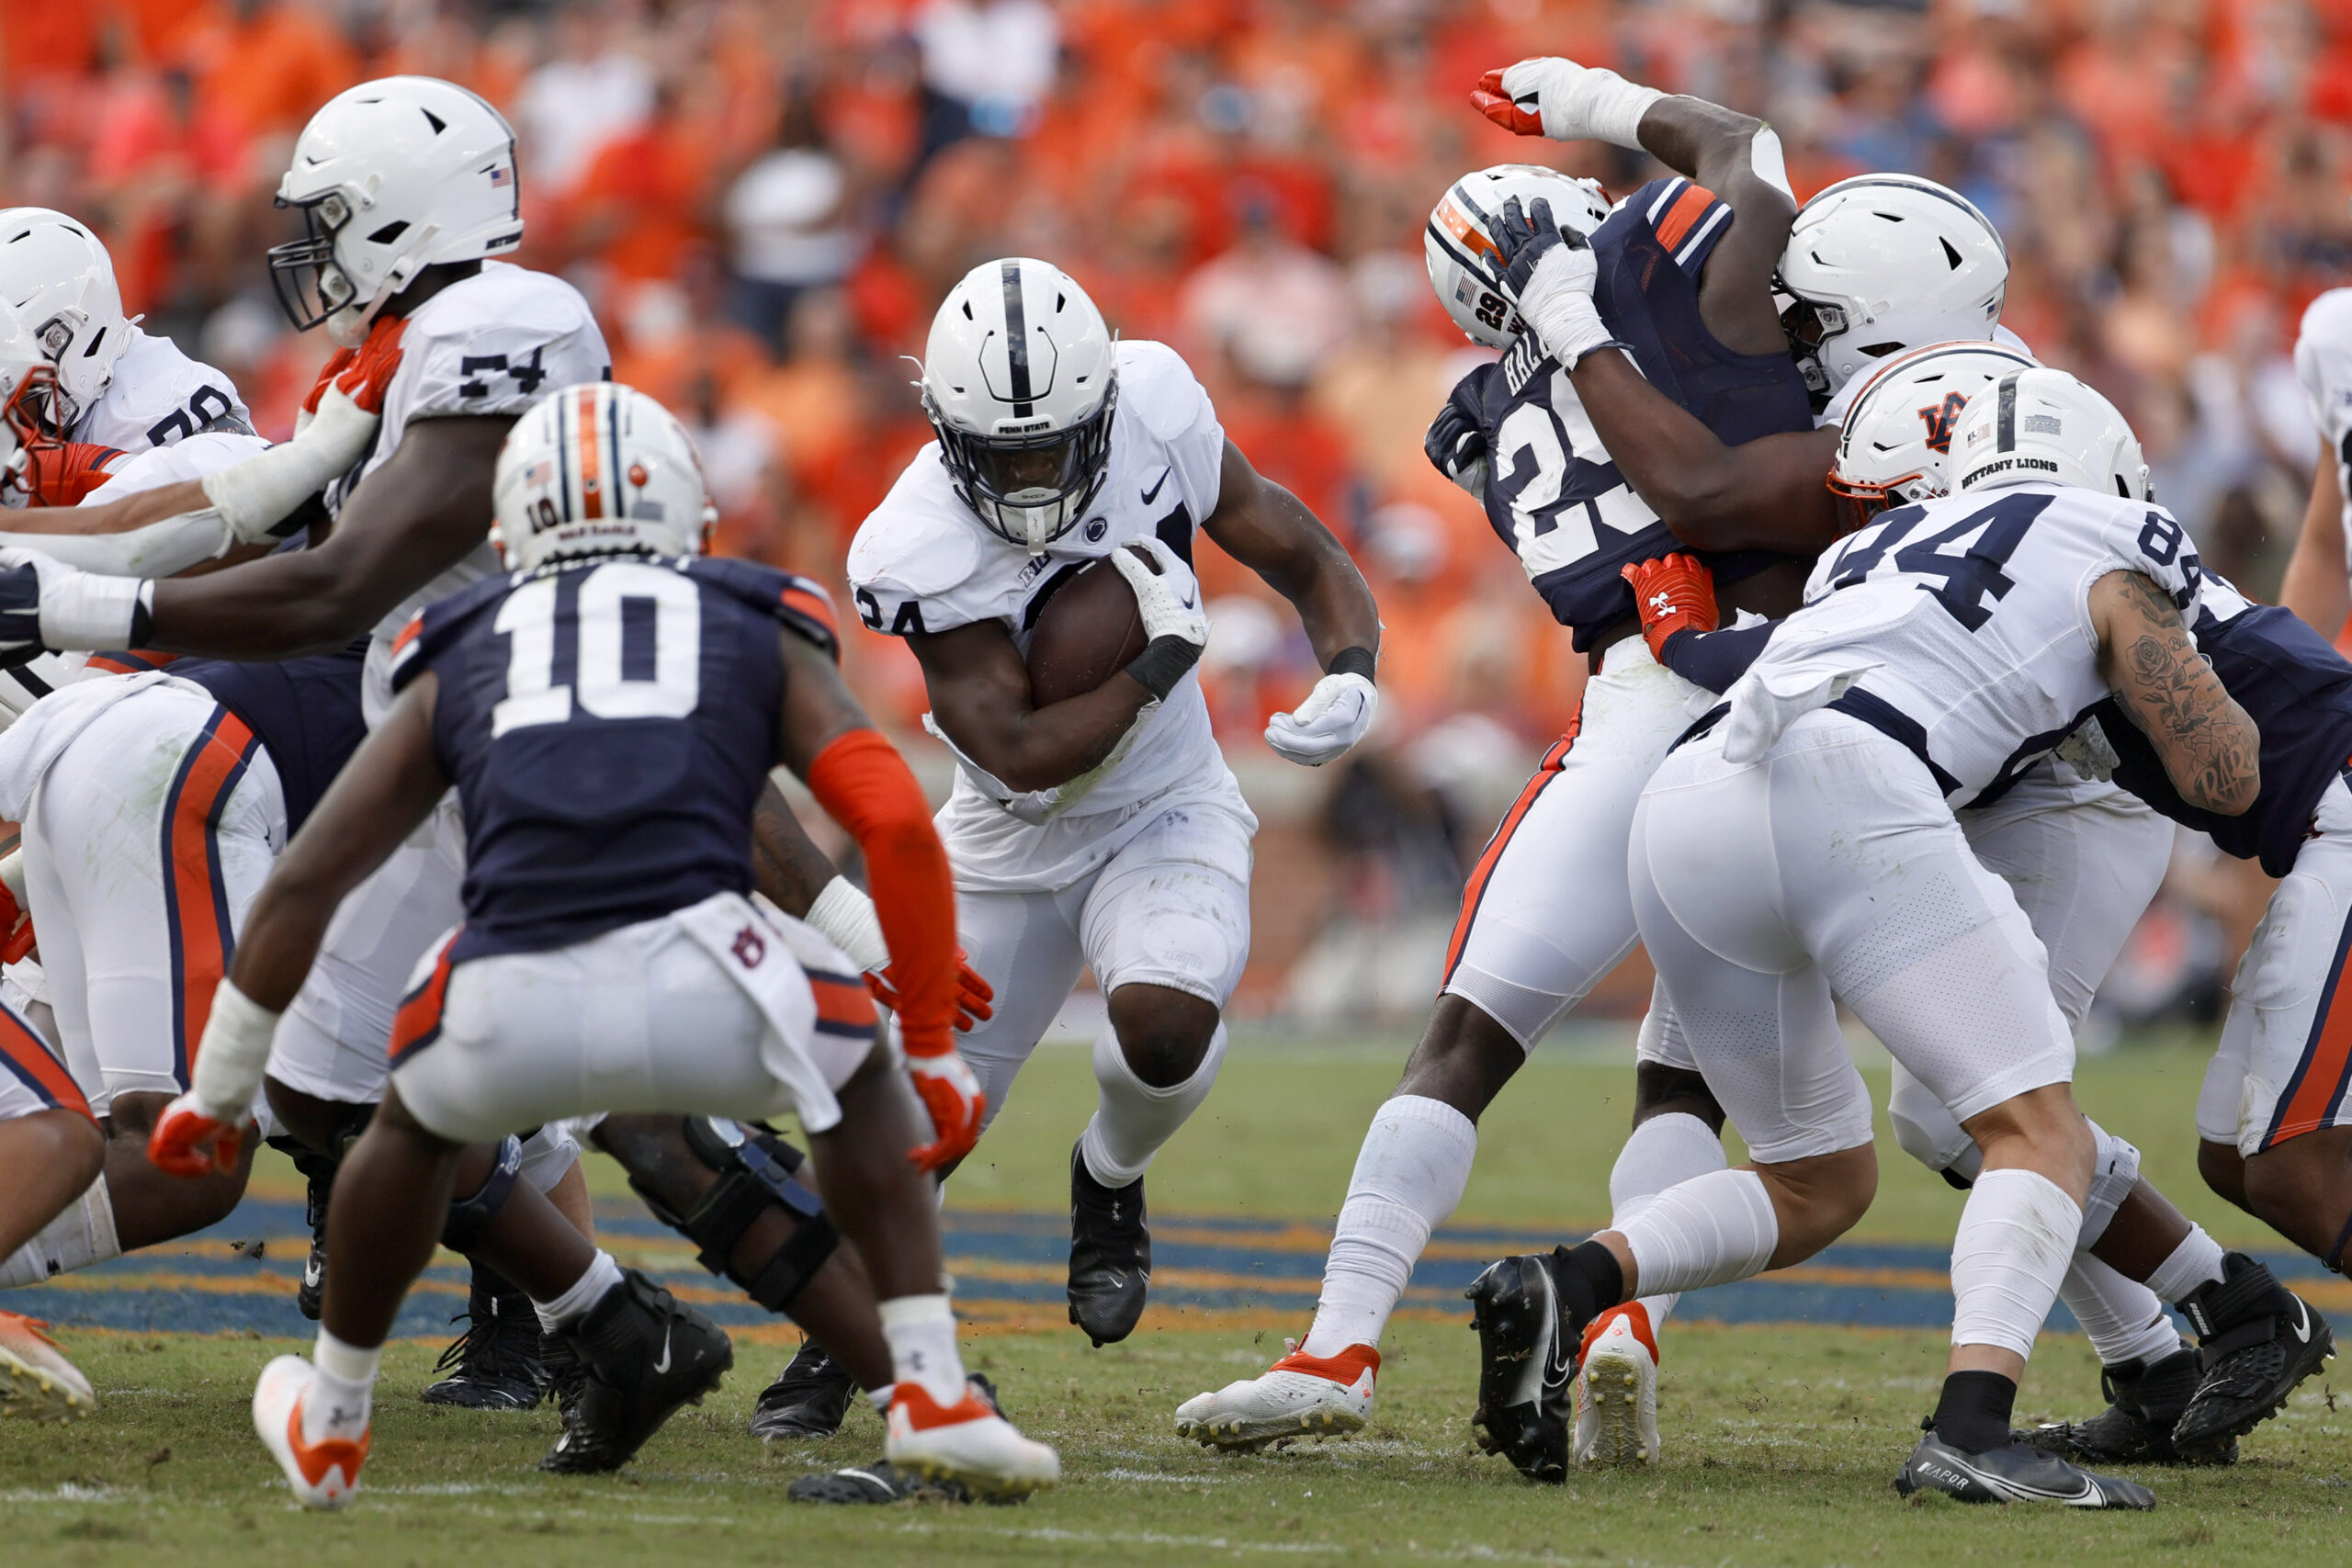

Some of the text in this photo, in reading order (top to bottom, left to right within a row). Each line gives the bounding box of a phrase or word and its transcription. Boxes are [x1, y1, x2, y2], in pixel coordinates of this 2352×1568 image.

[1476, 292, 1508, 332] 29
[999, 421, 1050, 434] PENN STATE
[2017, 458, 2059, 473] LIONS
[526, 497, 558, 535] 10
[2137, 511, 2201, 611] 84
[492, 561, 700, 740] 10
[1917, 1461, 1969, 1490] VAPOR
